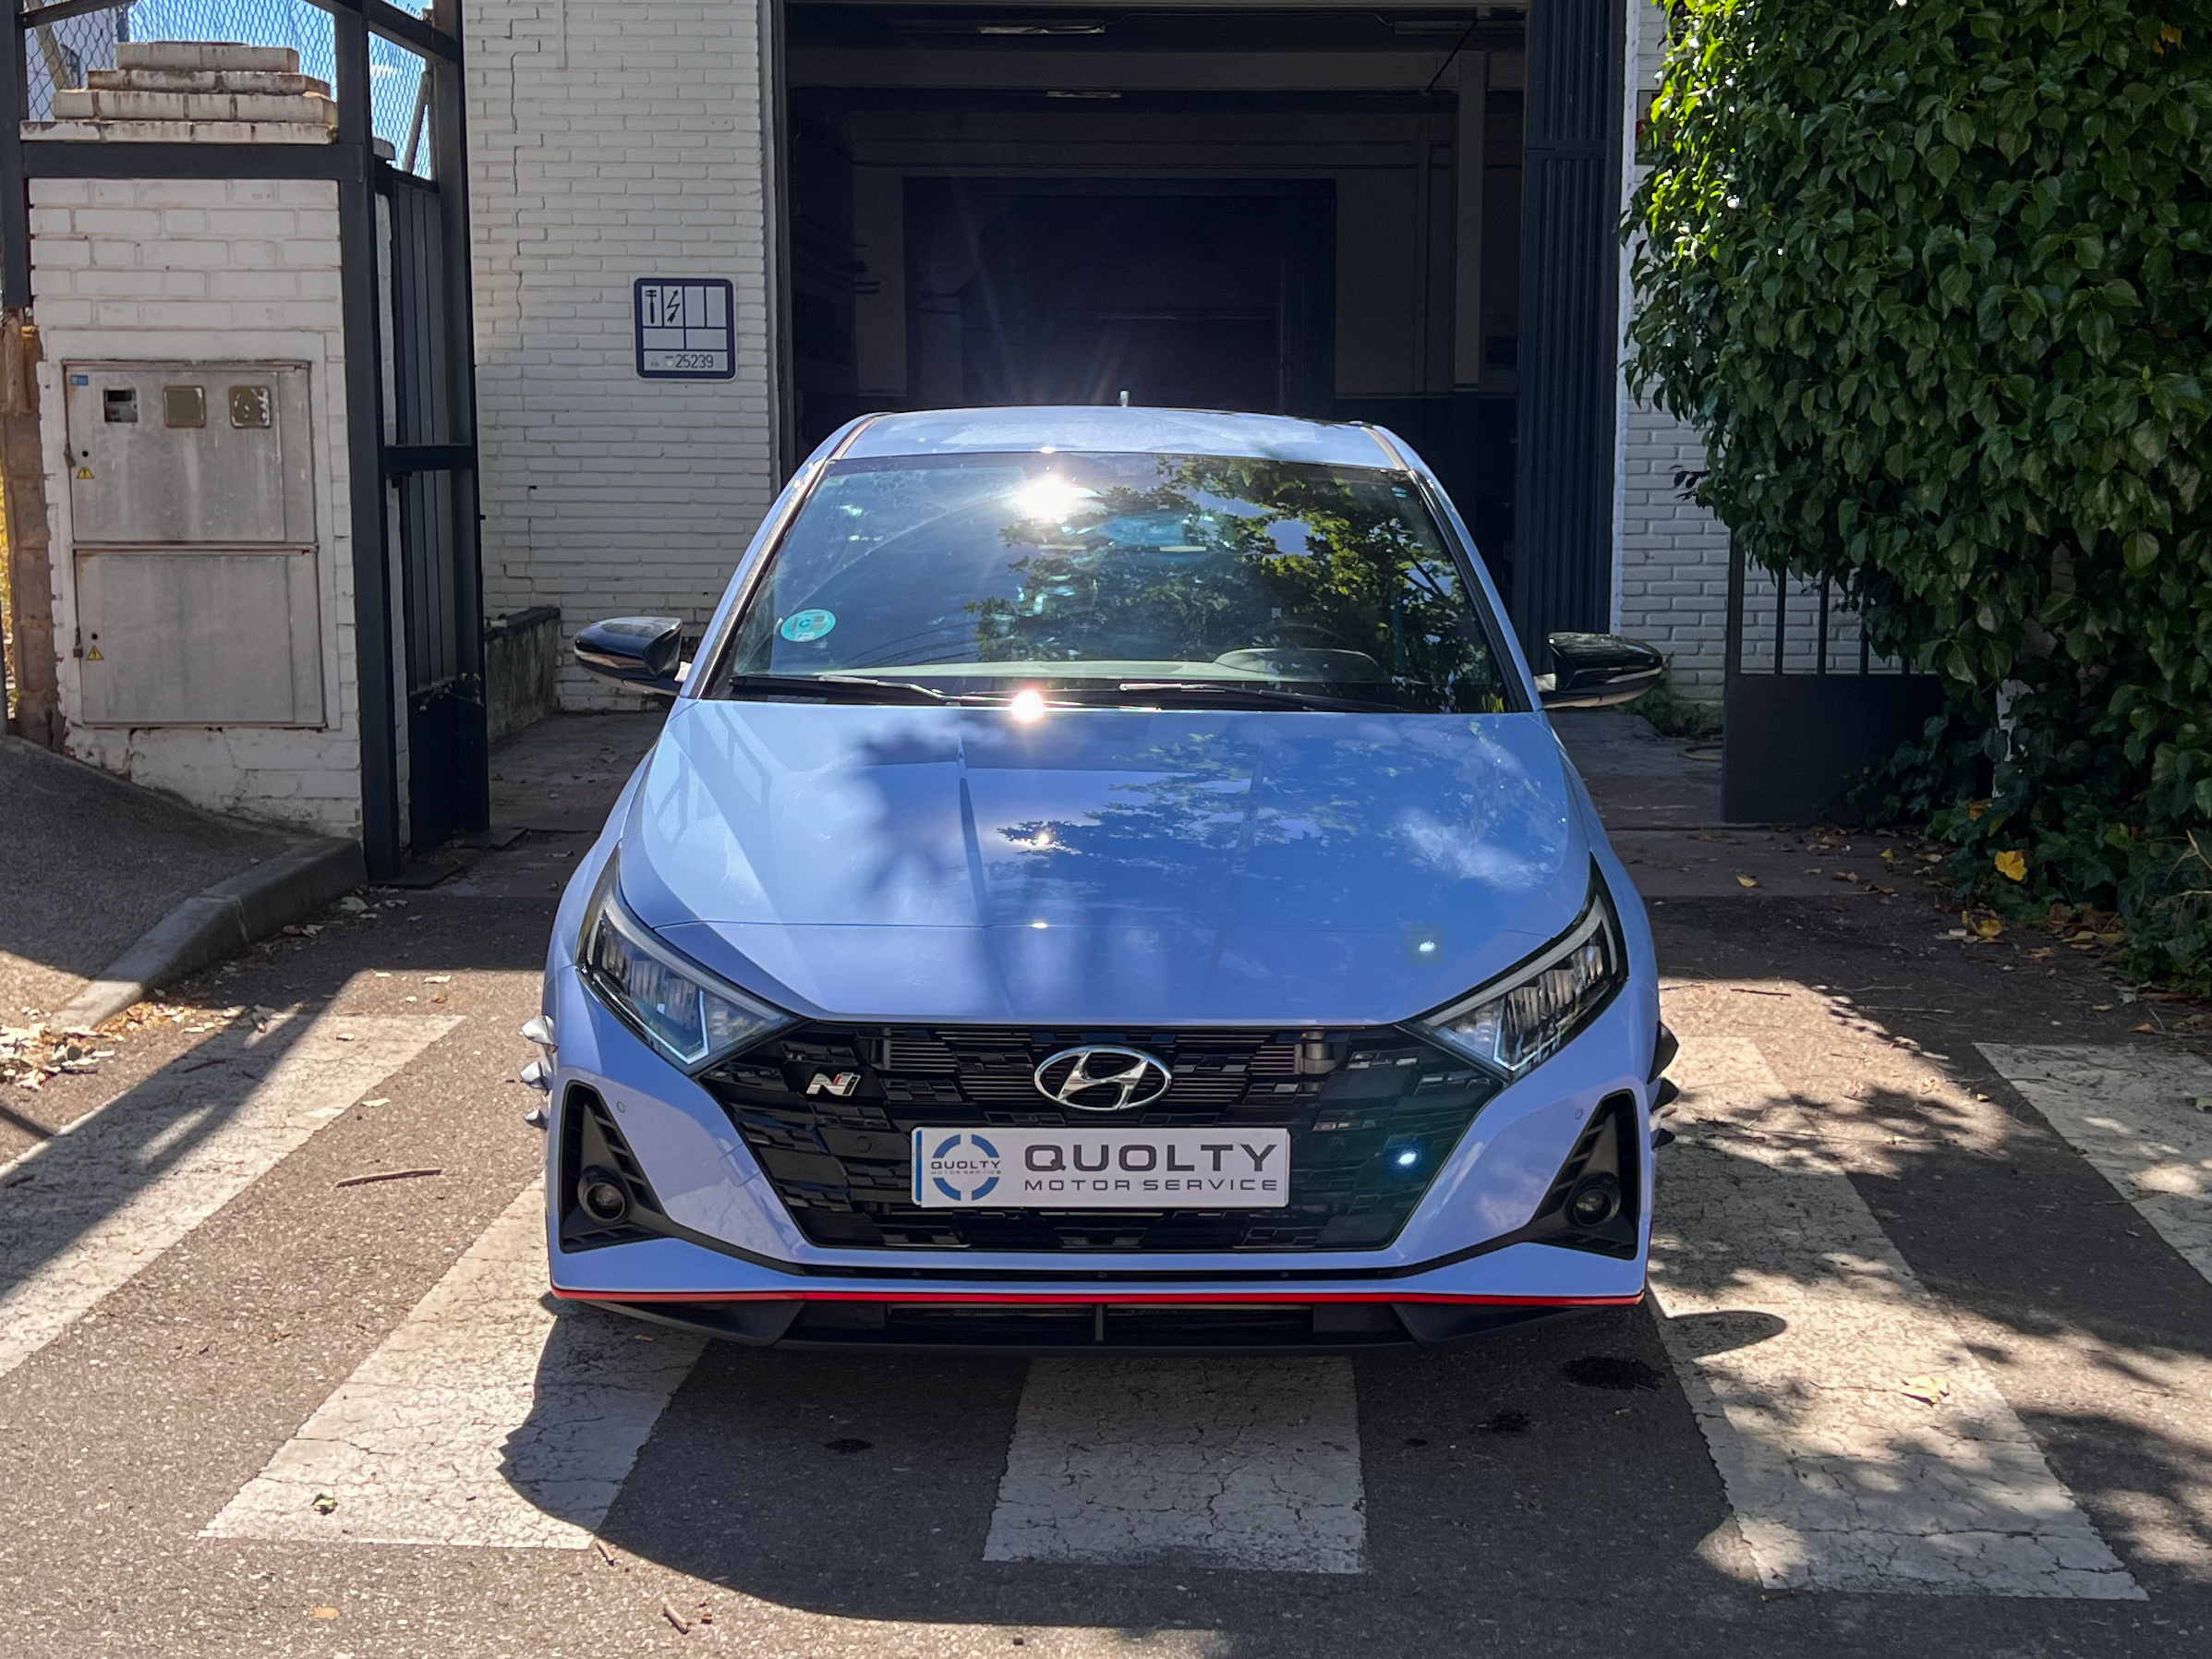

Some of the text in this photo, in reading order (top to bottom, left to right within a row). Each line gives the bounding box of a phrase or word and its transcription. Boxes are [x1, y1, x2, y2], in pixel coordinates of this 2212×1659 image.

[675, 354, 714, 369] 25239
[931, 1160, 1001, 1169] QUOLTY
[1024, 1144, 1277, 1172] QUOLTY
[1024, 1179, 1277, 1192] MOTOR SERVICE
